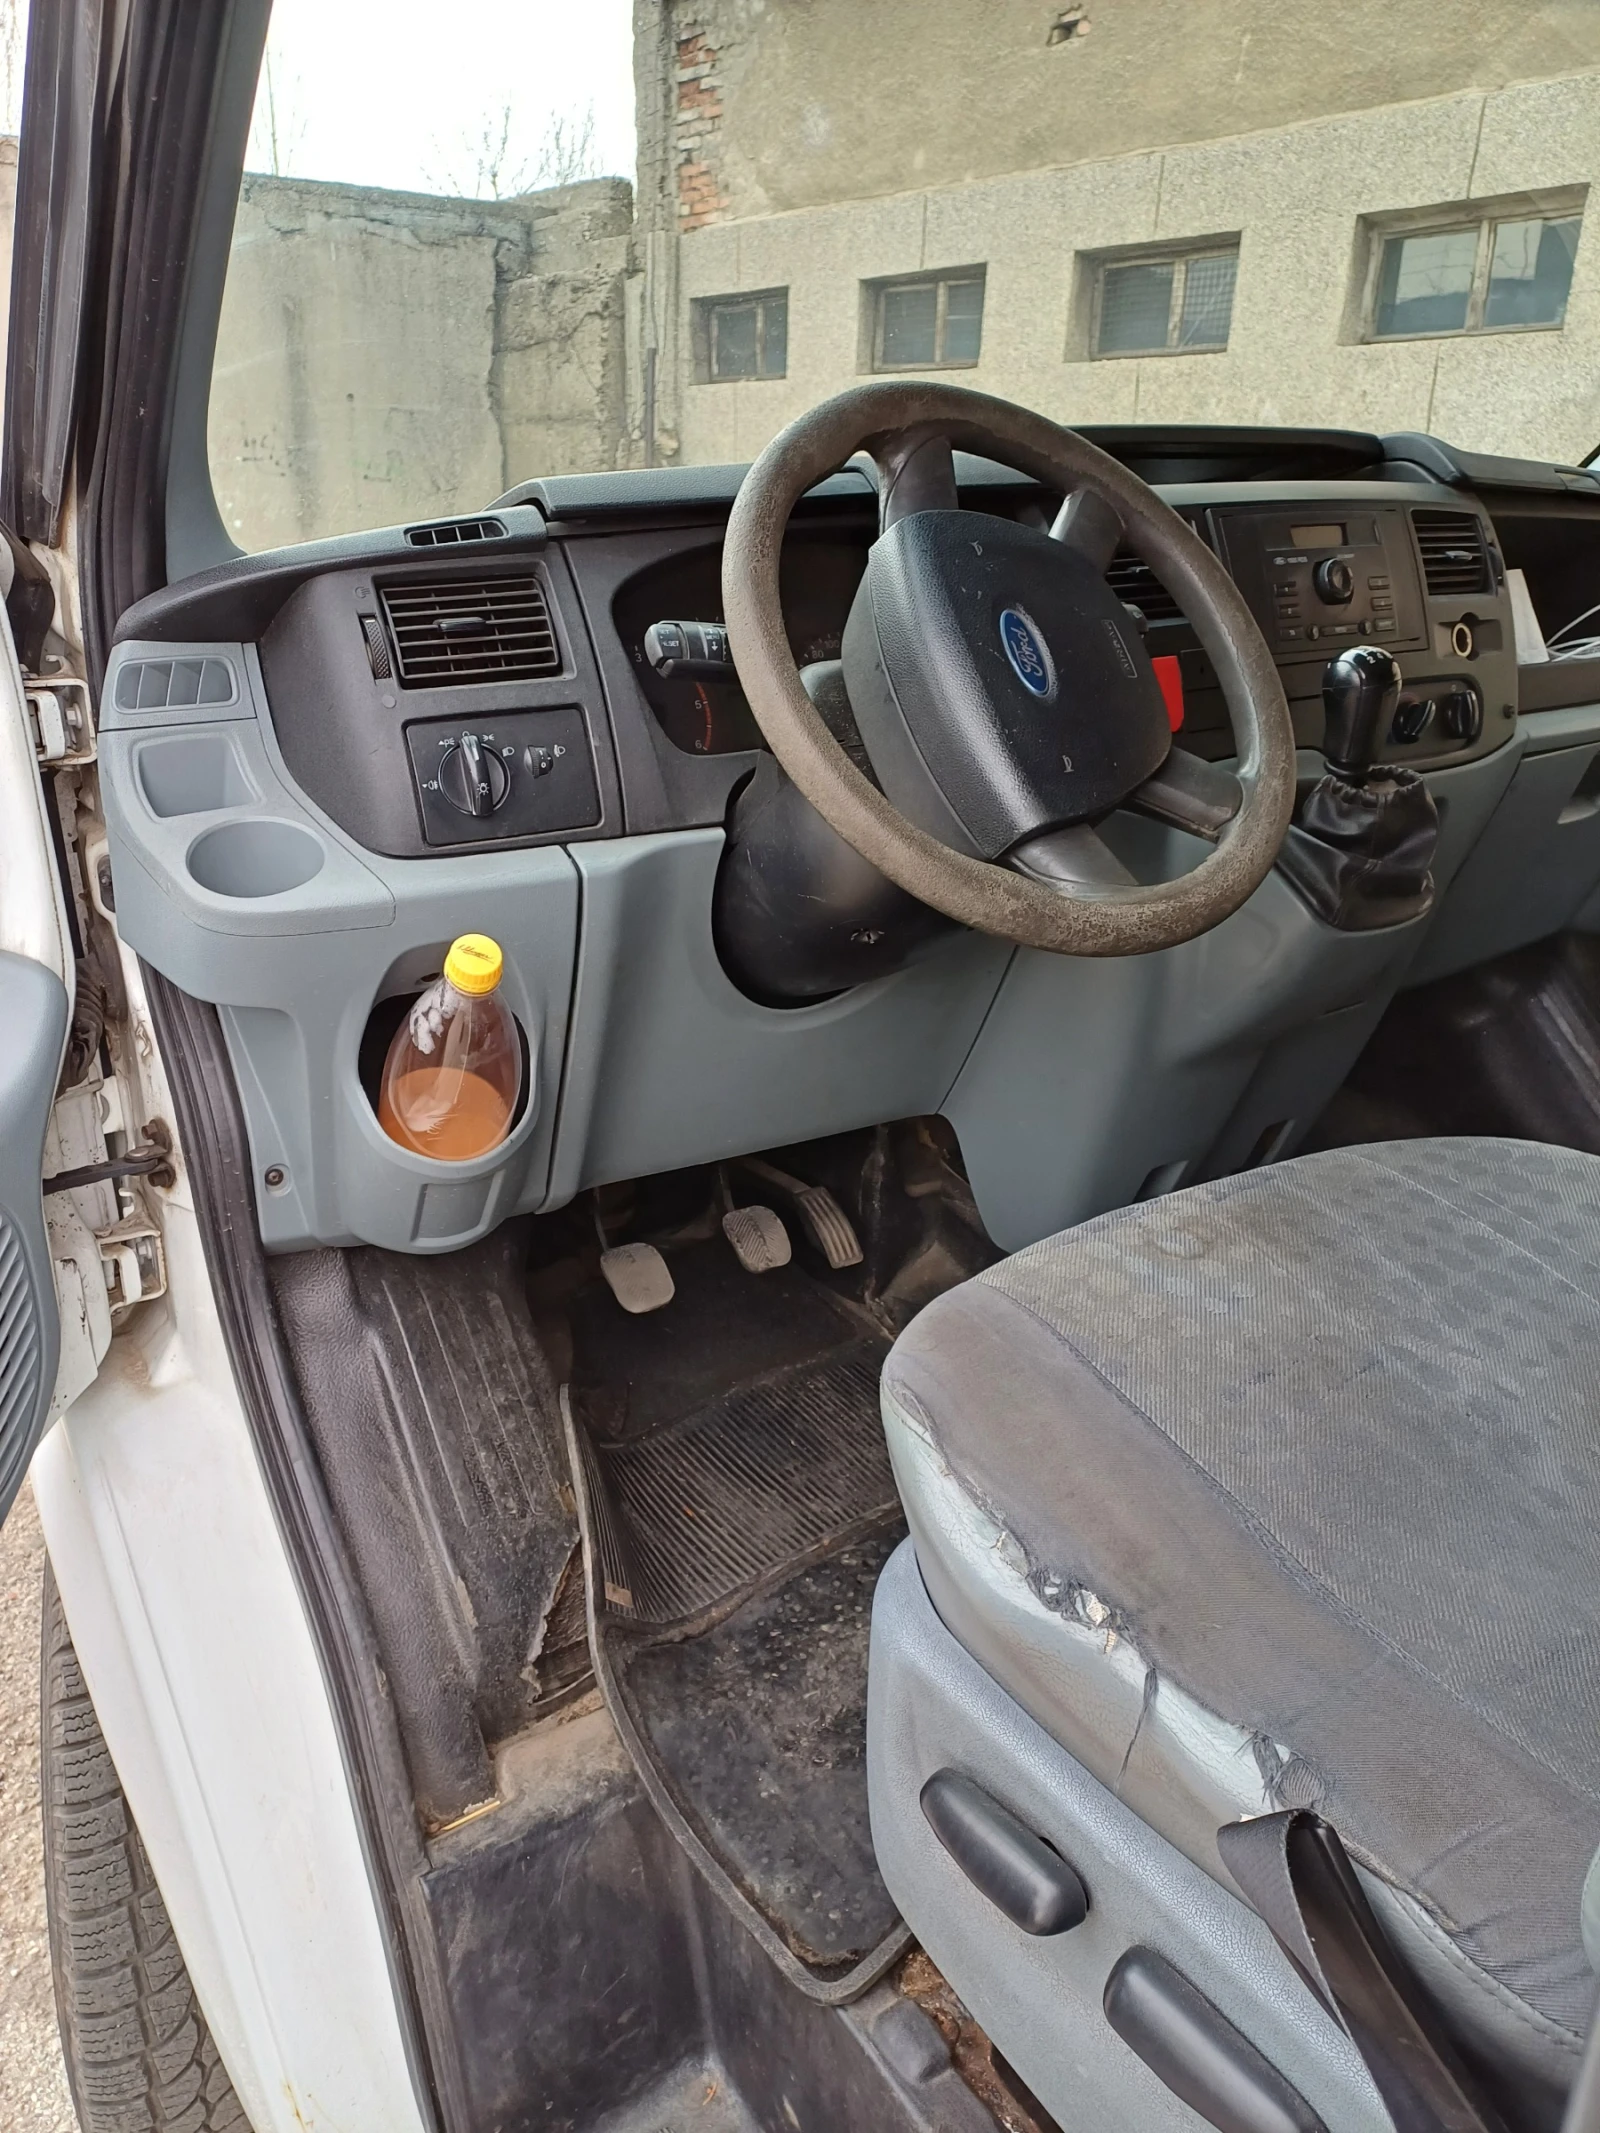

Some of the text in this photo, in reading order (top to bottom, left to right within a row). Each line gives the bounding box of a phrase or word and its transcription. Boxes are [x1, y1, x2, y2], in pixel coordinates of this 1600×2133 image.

[811, 650, 825, 659] 80
[1010, 626, 1043, 676] Ford
[634, 652, 643, 663] 3
[1366, 655, 1377, 665] 2
[694, 699, 703, 710] 5
[694, 739, 703, 749] 6
